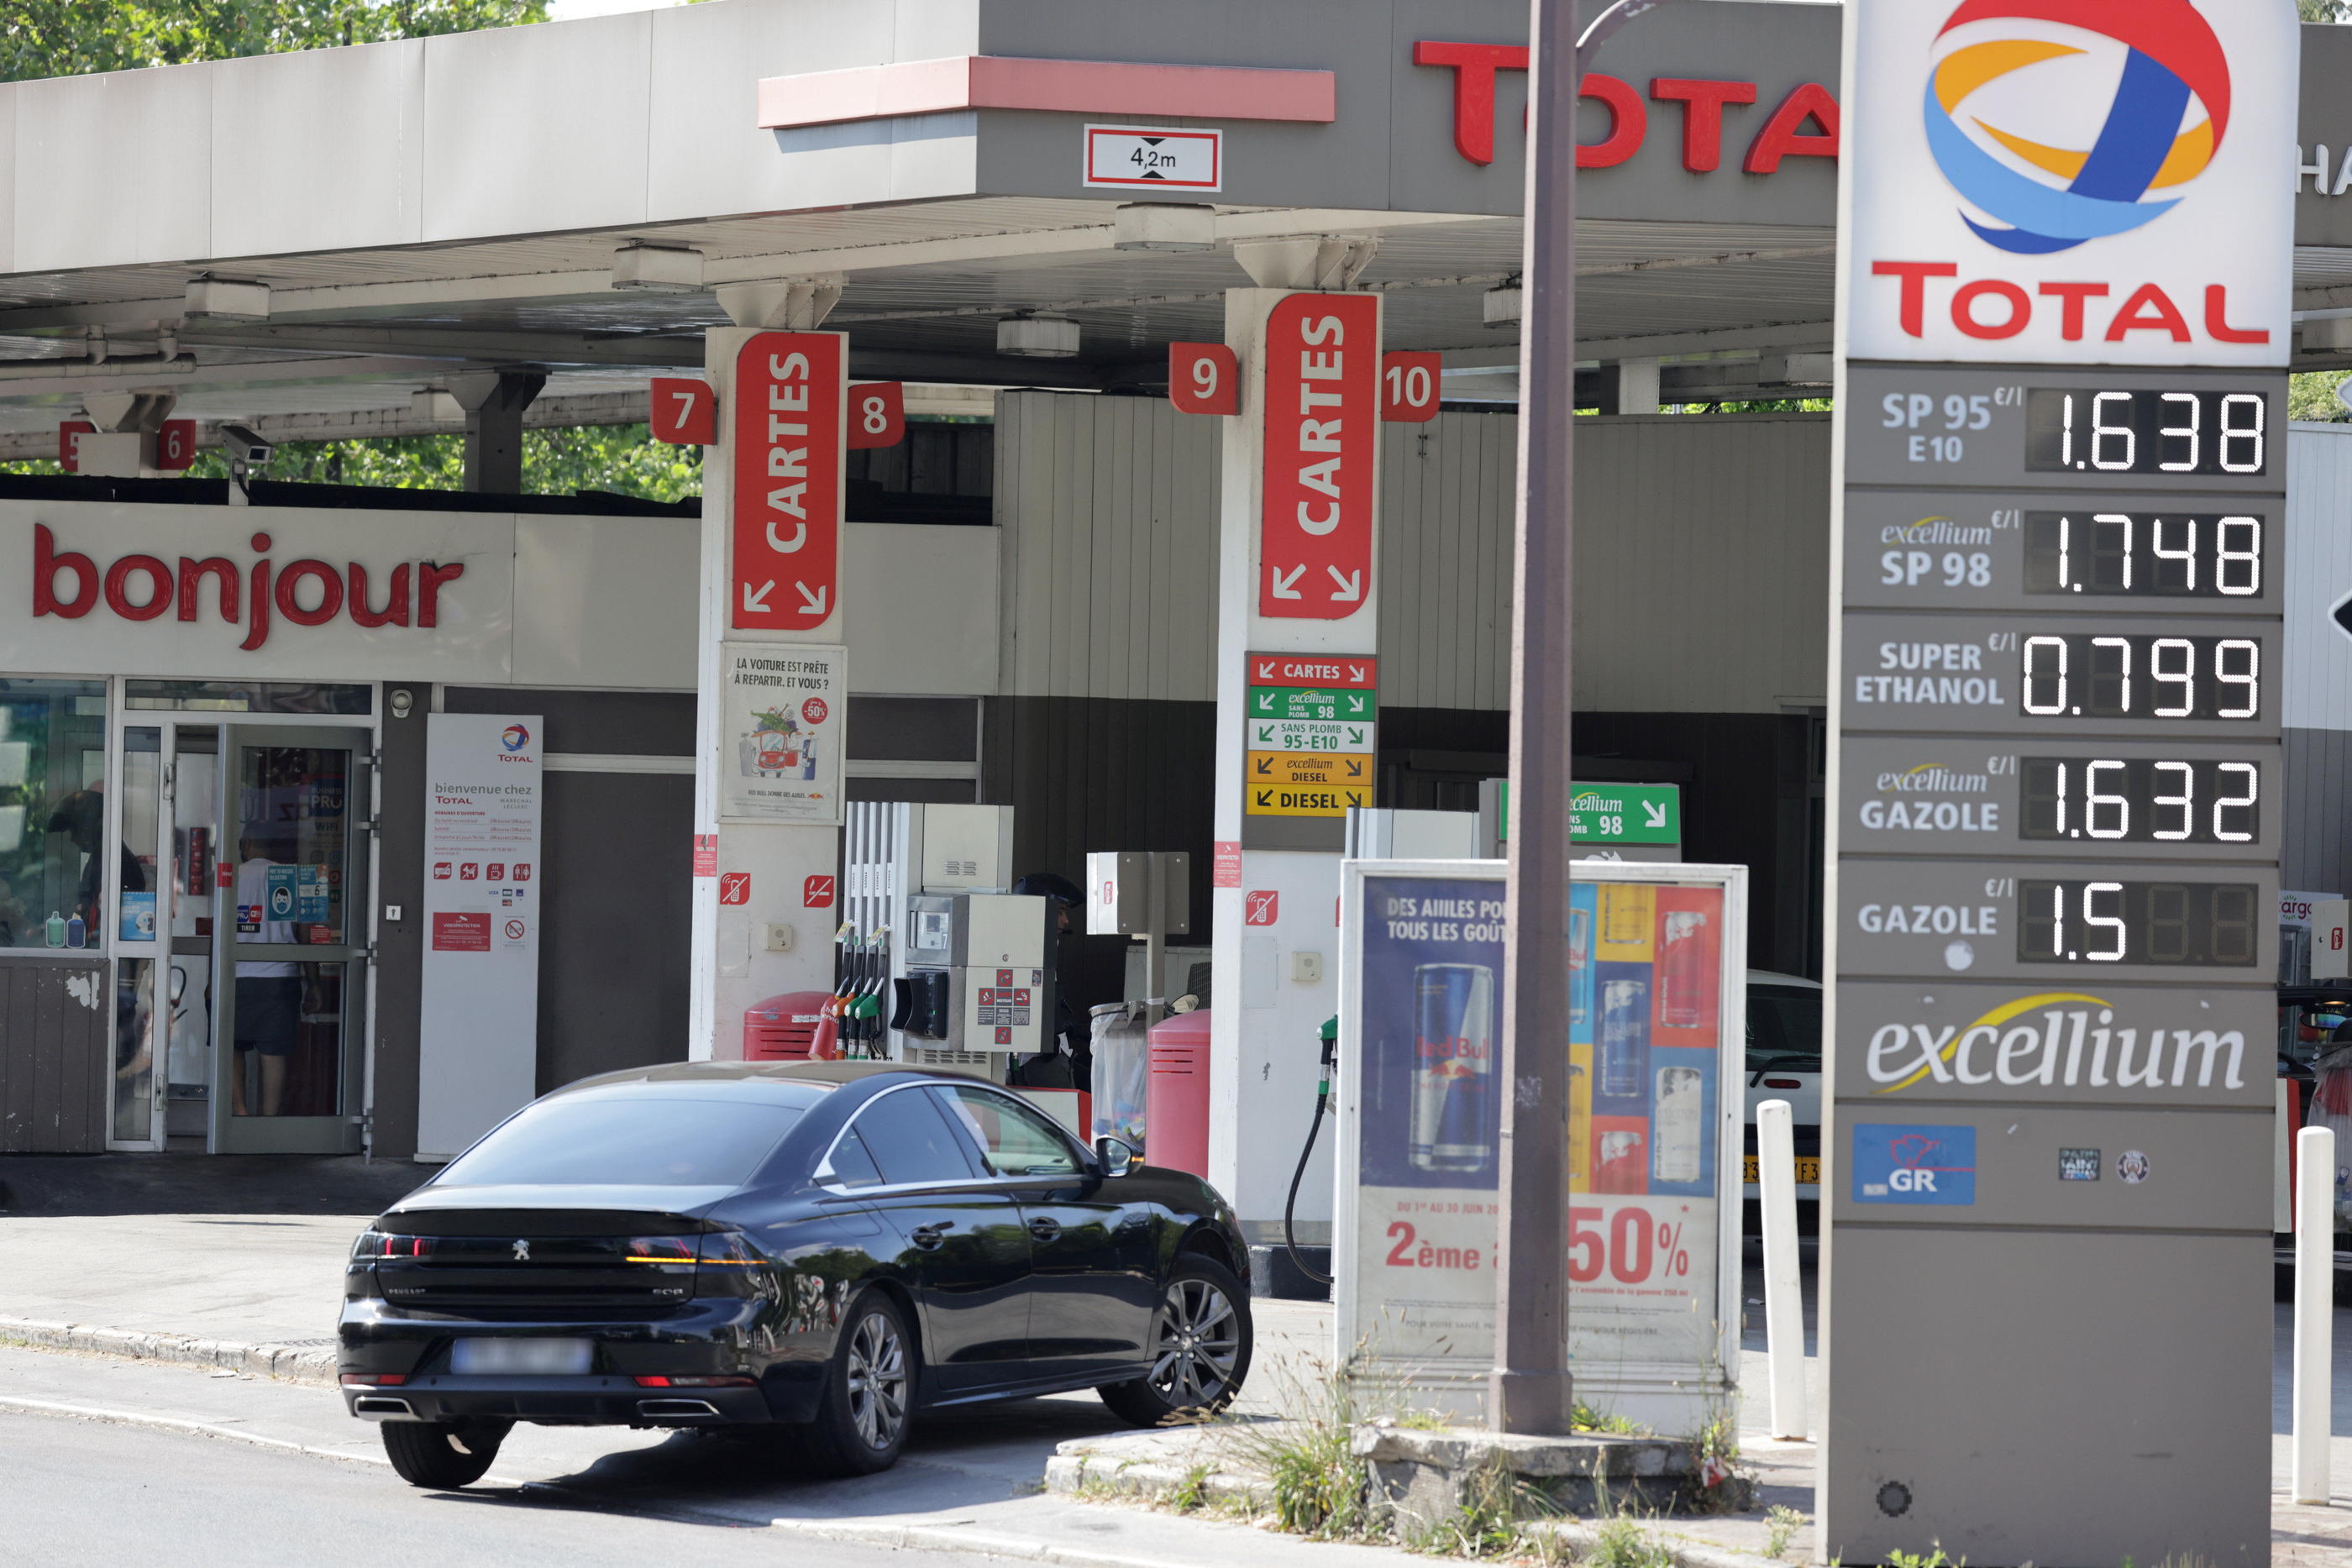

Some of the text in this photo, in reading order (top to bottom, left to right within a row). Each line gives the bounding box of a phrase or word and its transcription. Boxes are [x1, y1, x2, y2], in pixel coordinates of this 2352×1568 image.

[1131, 148, 1175, 169] 4,2m
[1872, 260, 2270, 344] TOTAL
[1192, 358, 1217, 399] 9
[1386, 365, 1431, 408] 10
[672, 392, 696, 429] 7
[863, 396, 888, 434] 8
[1882, 393, 1934, 429] SP
[1943, 394, 1992, 430] 95
[1297, 315, 1344, 536] CARTES
[2062, 391, 2265, 473] 1.638
[168, 430, 181, 459] 6
[765, 352, 810, 553] CARTES
[1881, 520, 1992, 546] excellium
[1882, 550, 1992, 587] SP 98
[2059, 514, 2260, 595] 1.748
[33, 522, 465, 651] bonjour
[737, 658, 828, 674] LA VOITURE EST PRÊTE
[1880, 642, 1982, 671] SUPER
[743, 674, 785, 688] REPARTIR.
[787, 677, 796, 687] ET
[798, 678, 822, 689] VOUS
[1284, 664, 1340, 679] CARTES
[2024, 637, 2259, 718] 0.799
[1289, 692, 1335, 704] excellium
[1856, 675, 2005, 705] ETHANOL
[1318, 706, 1335, 719] 98
[1281, 723, 1341, 734] SANS PLOMB
[497, 754, 533, 763] TOTAL
[1287, 758, 1333, 769] excellium
[435, 783, 532, 794] bienvenue chez
[1292, 773, 1327, 782] DIESEL
[1877, 768, 1987, 793] excellium
[436, 796, 473, 805] TOTAL
[1280, 793, 1339, 808] DIESEL
[2057, 760, 2257, 842] 1.632
[1599, 815, 1623, 835] 98
[1860, 800, 1998, 831] GAZOLE
[1388, 898, 1417, 916] DES
[1480, 900, 1505, 919] PO
[1857, 904, 1998, 935] GAZOLE
[2054, 882, 2126, 961] 1.5
[1387, 920, 1428, 940] TOUS
[1432, 922, 1458, 941] LES
[1866, 1009, 2245, 1090] excellium
[1794, 1162, 1818, 1180] F3
[1889, 1168, 1938, 1192] GR
[1398, 1202, 1410, 1212] DU
[1430, 1203, 1443, 1213] AU
[1446, 1203, 1458, 1213] 30
[1462, 1204, 1483, 1214] JUIN
[1385, 1221, 1479, 1271] 2ème
